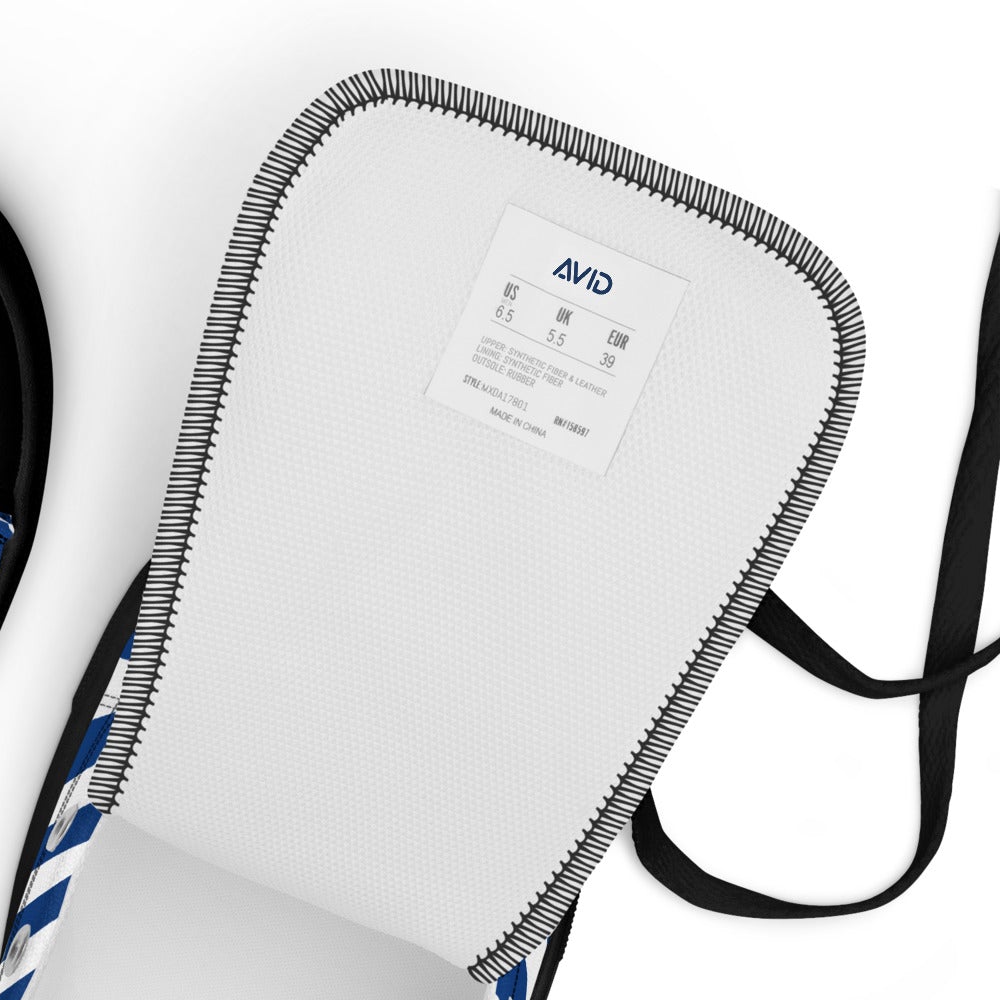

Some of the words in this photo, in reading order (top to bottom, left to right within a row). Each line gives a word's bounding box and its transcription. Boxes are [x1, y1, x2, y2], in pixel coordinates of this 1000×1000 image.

[553, 258, 613, 295] AVID
[495, 305, 515, 323] 6.5
[546, 329, 566, 347] 5.5
[600, 352, 616, 368] 39
[503, 282, 520, 301] US
[556, 307, 573, 326] UK
[607, 329, 629, 350] EUR
[471, 353, 507, 376] OUTSOLE:
[506, 368, 536, 388] RUBBER
[476, 344, 502, 361] LINING:
[504, 355, 542, 378] SYNTHETIC
[542, 372, 564, 388] FIBER
[480, 335, 507, 352] UPPER:
[508, 347, 547, 369] SYNTHETIC
[547, 364, 569, 381] FIBER
[575, 377, 608, 398] LEATHER
[489, 406, 513, 424] MADE
[513, 417, 521, 427] IN
[522, 421, 547, 438] CHINA
